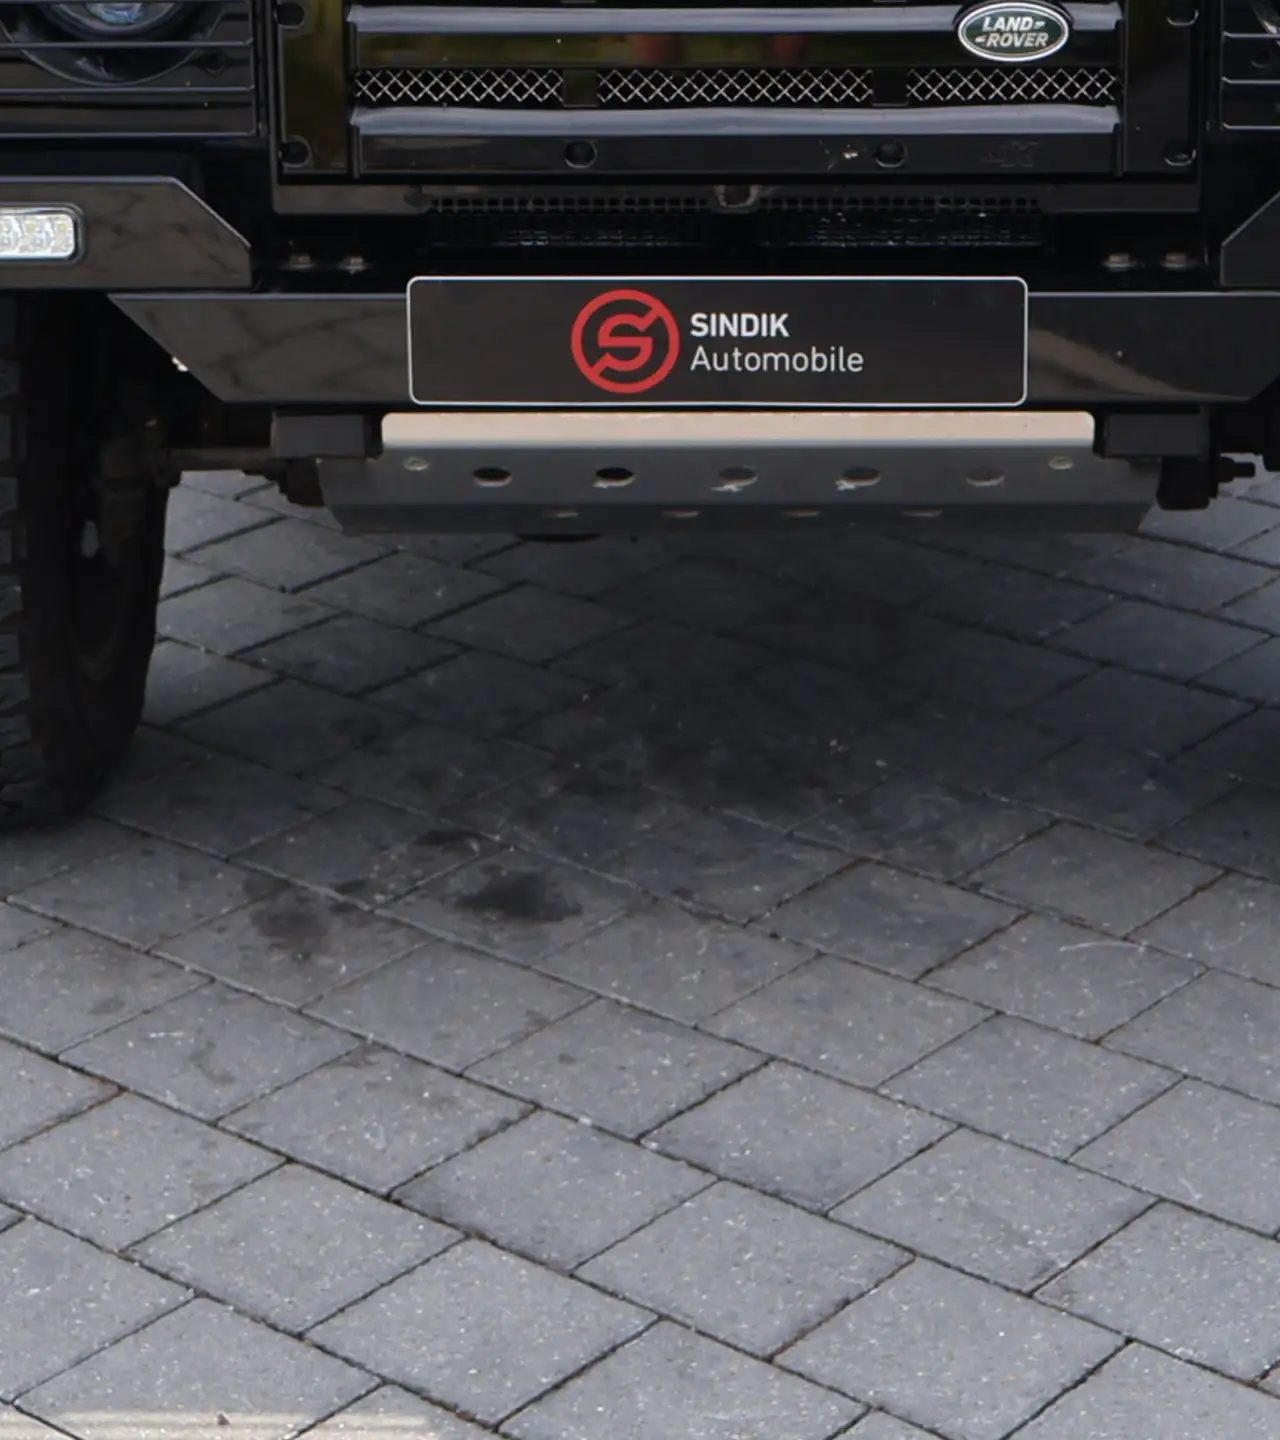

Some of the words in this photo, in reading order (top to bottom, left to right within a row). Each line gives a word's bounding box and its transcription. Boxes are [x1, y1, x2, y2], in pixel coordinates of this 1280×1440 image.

[982, 16, 1034, 32] LAND
[986, 32, 1050, 47] ROVER
[689, 312, 790, 338] SINDIK
[689, 345, 864, 372] Automobile
